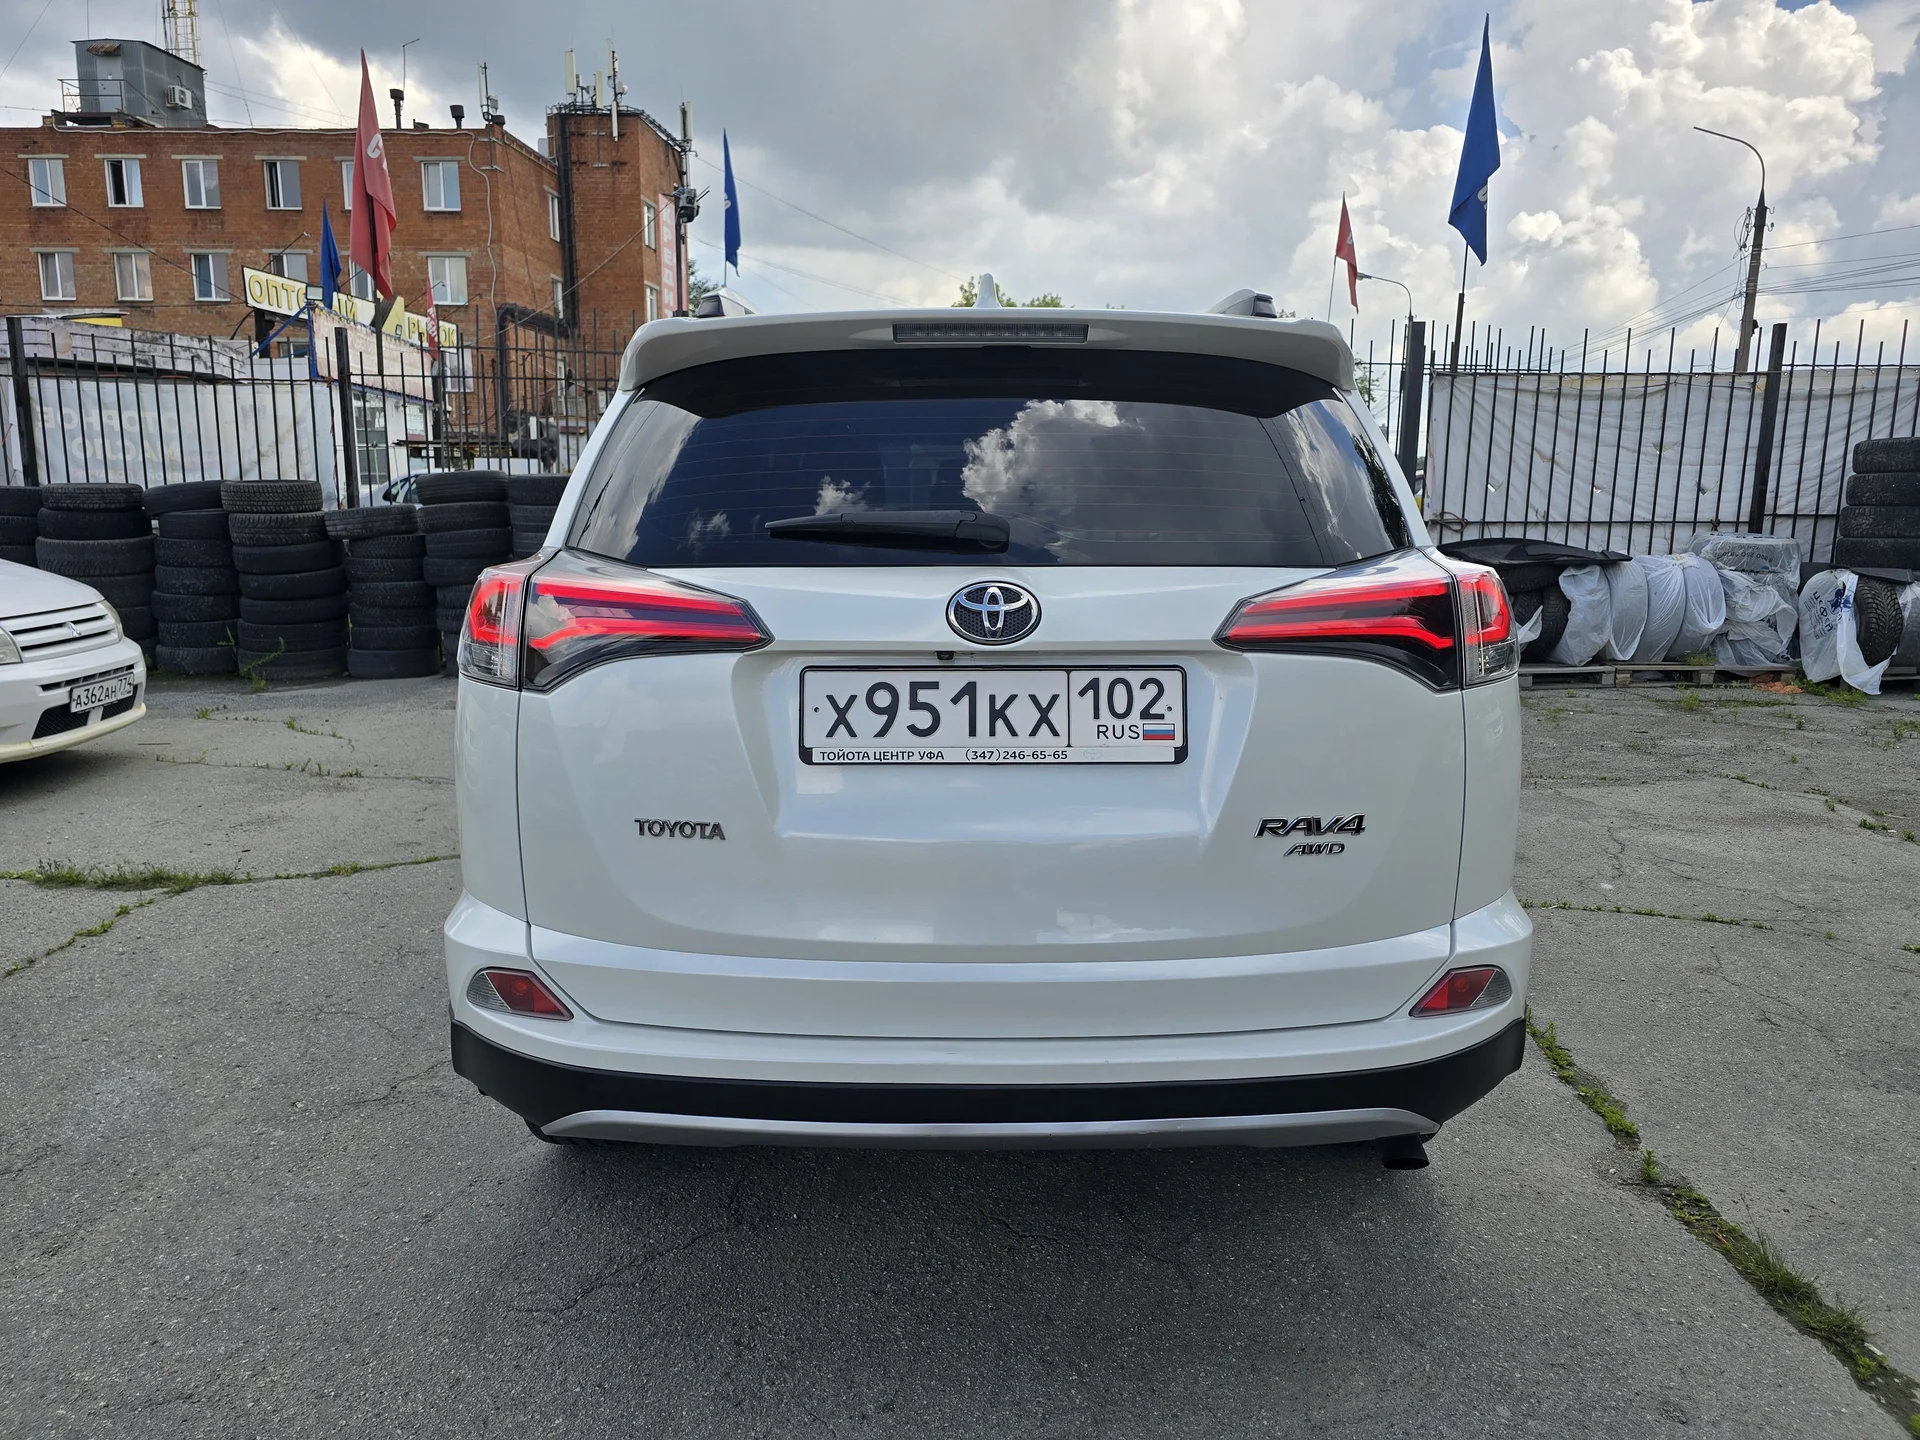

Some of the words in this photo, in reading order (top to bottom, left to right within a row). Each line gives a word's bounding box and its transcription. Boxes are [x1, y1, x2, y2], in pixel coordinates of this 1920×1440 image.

[407, 316, 457, 347] РЫОК
[825, 681, 1061, 738] Х951КХ
[1078, 677, 1165, 719] 102
[1096, 724, 1140, 740] RUS
[820, 749, 871, 761] ТОЙОТА
[873, 751, 915, 762] ЦЕНТР
[918, 751, 945, 761] УФА
[634, 817, 726, 840] TOYOTA
[1254, 813, 1366, 838] RAV4
[1283, 841, 1346, 857] AWD
